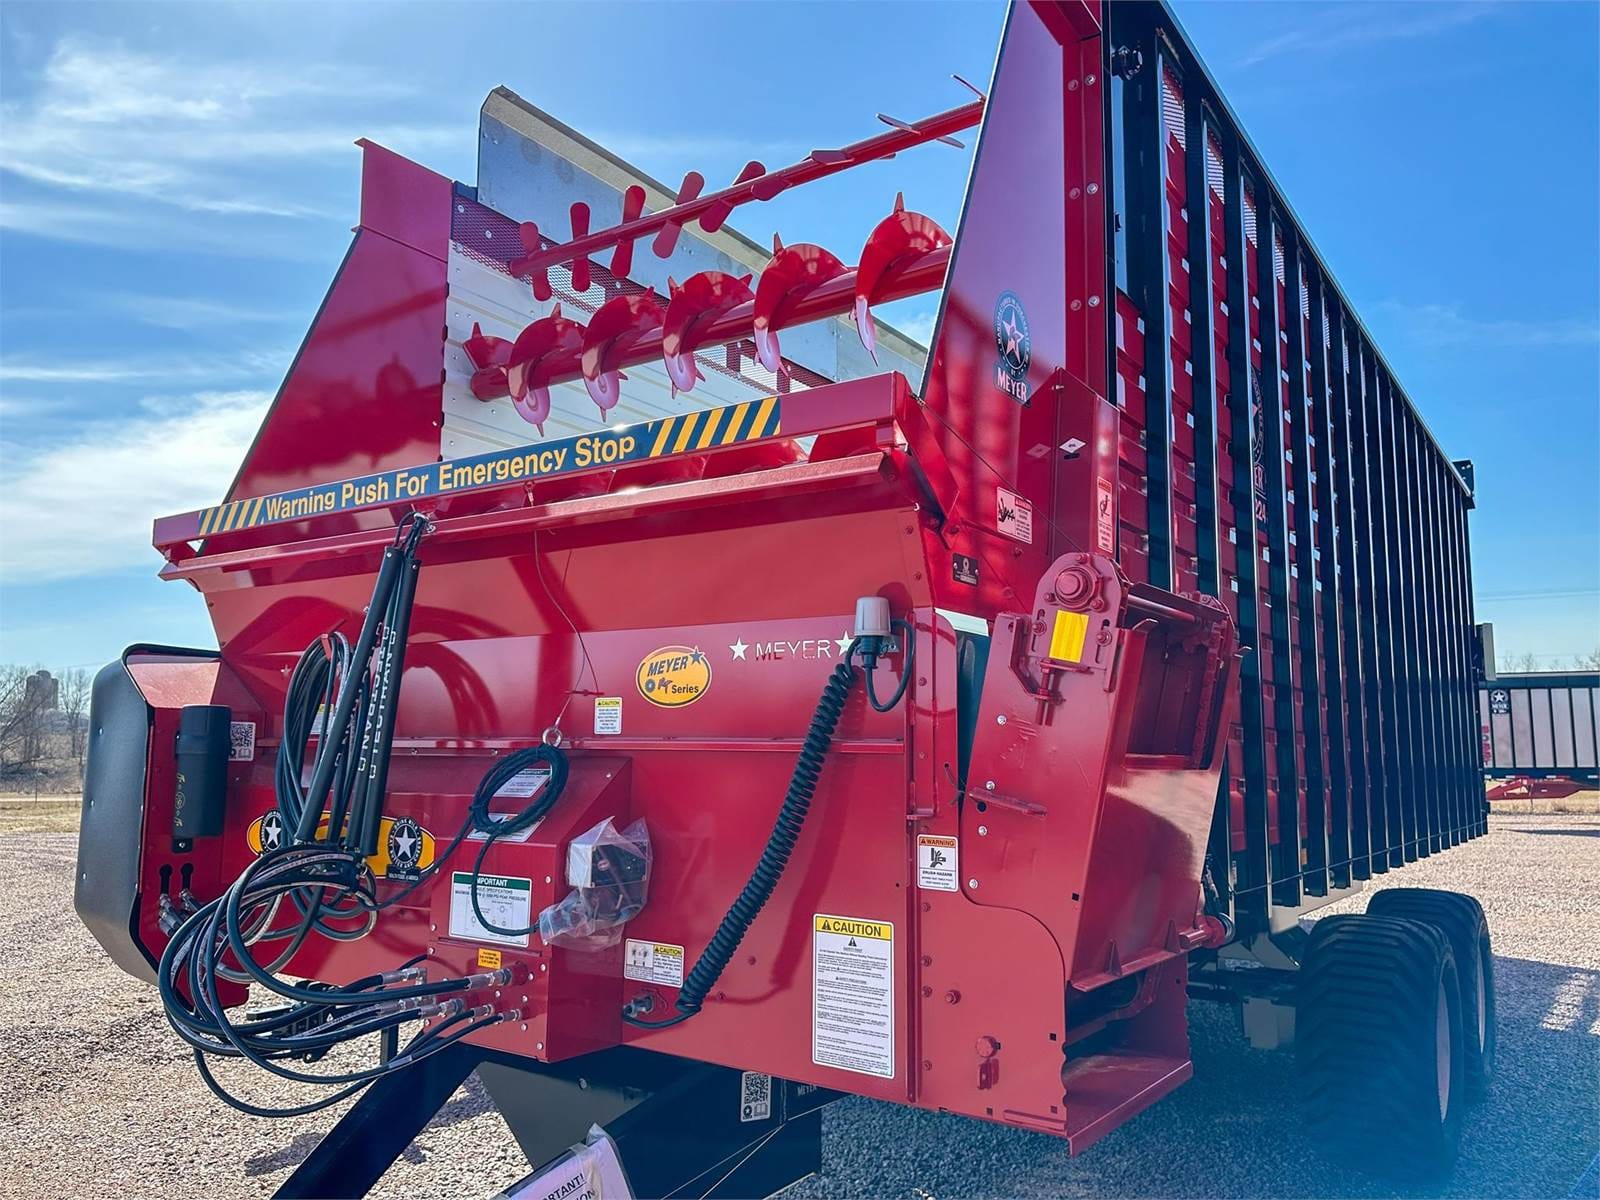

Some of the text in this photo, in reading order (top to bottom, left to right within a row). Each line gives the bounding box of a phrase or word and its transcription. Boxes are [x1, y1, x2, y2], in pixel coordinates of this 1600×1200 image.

[997, 367, 1027, 402] MEYER
[266, 434, 636, 522] Warning Push For Emergency Stop
[756, 639, 831, 661] MEYER
[647, 656, 689, 677] MEYER
[671, 684, 699, 694] Series
[926, 839, 954, 847] WARNING
[833, 921, 882, 937] CAUTION
[659, 947, 682, 955] CAUTION
